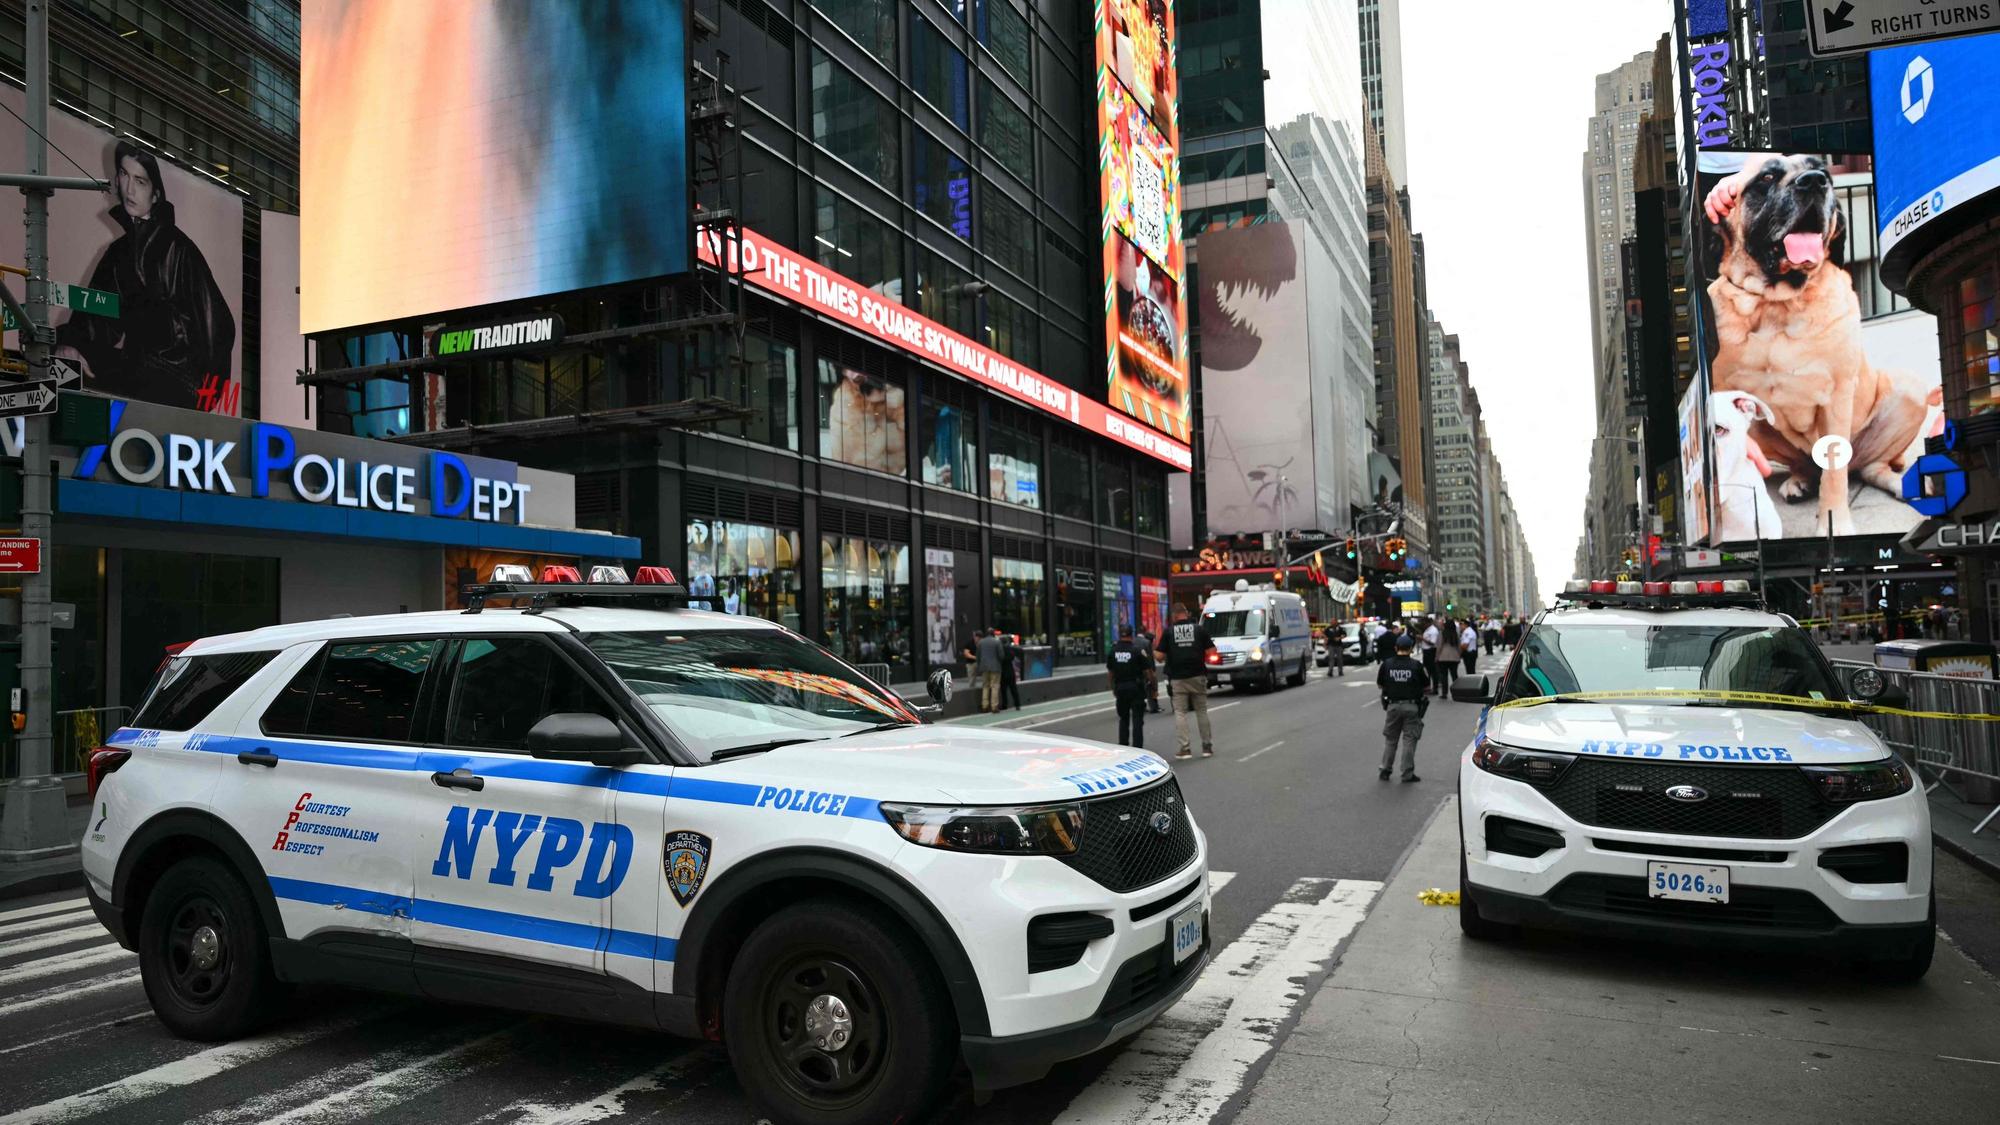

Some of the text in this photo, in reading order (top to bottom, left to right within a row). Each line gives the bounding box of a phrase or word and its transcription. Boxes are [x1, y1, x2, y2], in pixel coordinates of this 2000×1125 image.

[1871, 3, 1991, 35] RIGHT TURNS
[1893, 199, 1930, 238] CHASE
[80, 290, 89, 309] 7
[761, 247, 801, 292] THE
[803, 268, 859, 318] TIMES
[861, 296, 923, 346] SQUARE
[924, 326, 987, 376] SKYWALK
[988, 357, 1042, 401] AVAILABLE
[1042, 384, 1067, 412] NOW
[49, 366, 67, 380] AY
[26, 390, 48, 405] WAY
[251, 422, 416, 513] POLICE
[430, 451, 531, 525] DEPT
[1937, 521, 2000, 546] CHA
[0, 541, 30, 549] TANDING
[1173, 623, 1194, 633] NYPD
[1174, 632, 1195, 641] POLICE
[1115, 652, 1131, 660] NYPD
[1389, 669, 1412, 679] NYPD
[1581, 740, 1793, 762] NYPD POLICE
[757, 786, 846, 816] POLICE
[1675, 789, 1699, 798] Ford
[295, 793, 351, 817] COURTESY
[283, 811, 380, 843] PROFESSIONALISM
[677, 832, 700, 843] POLICE
[271, 831, 324, 856] RESPECT
[432, 805, 634, 900] NYPD
[666, 840, 708, 855] DEPARTMENT
[664, 859, 676, 890] CITY OF
[689, 861, 707, 897] NEW YORK
[1656, 872, 1705, 893] 5026
